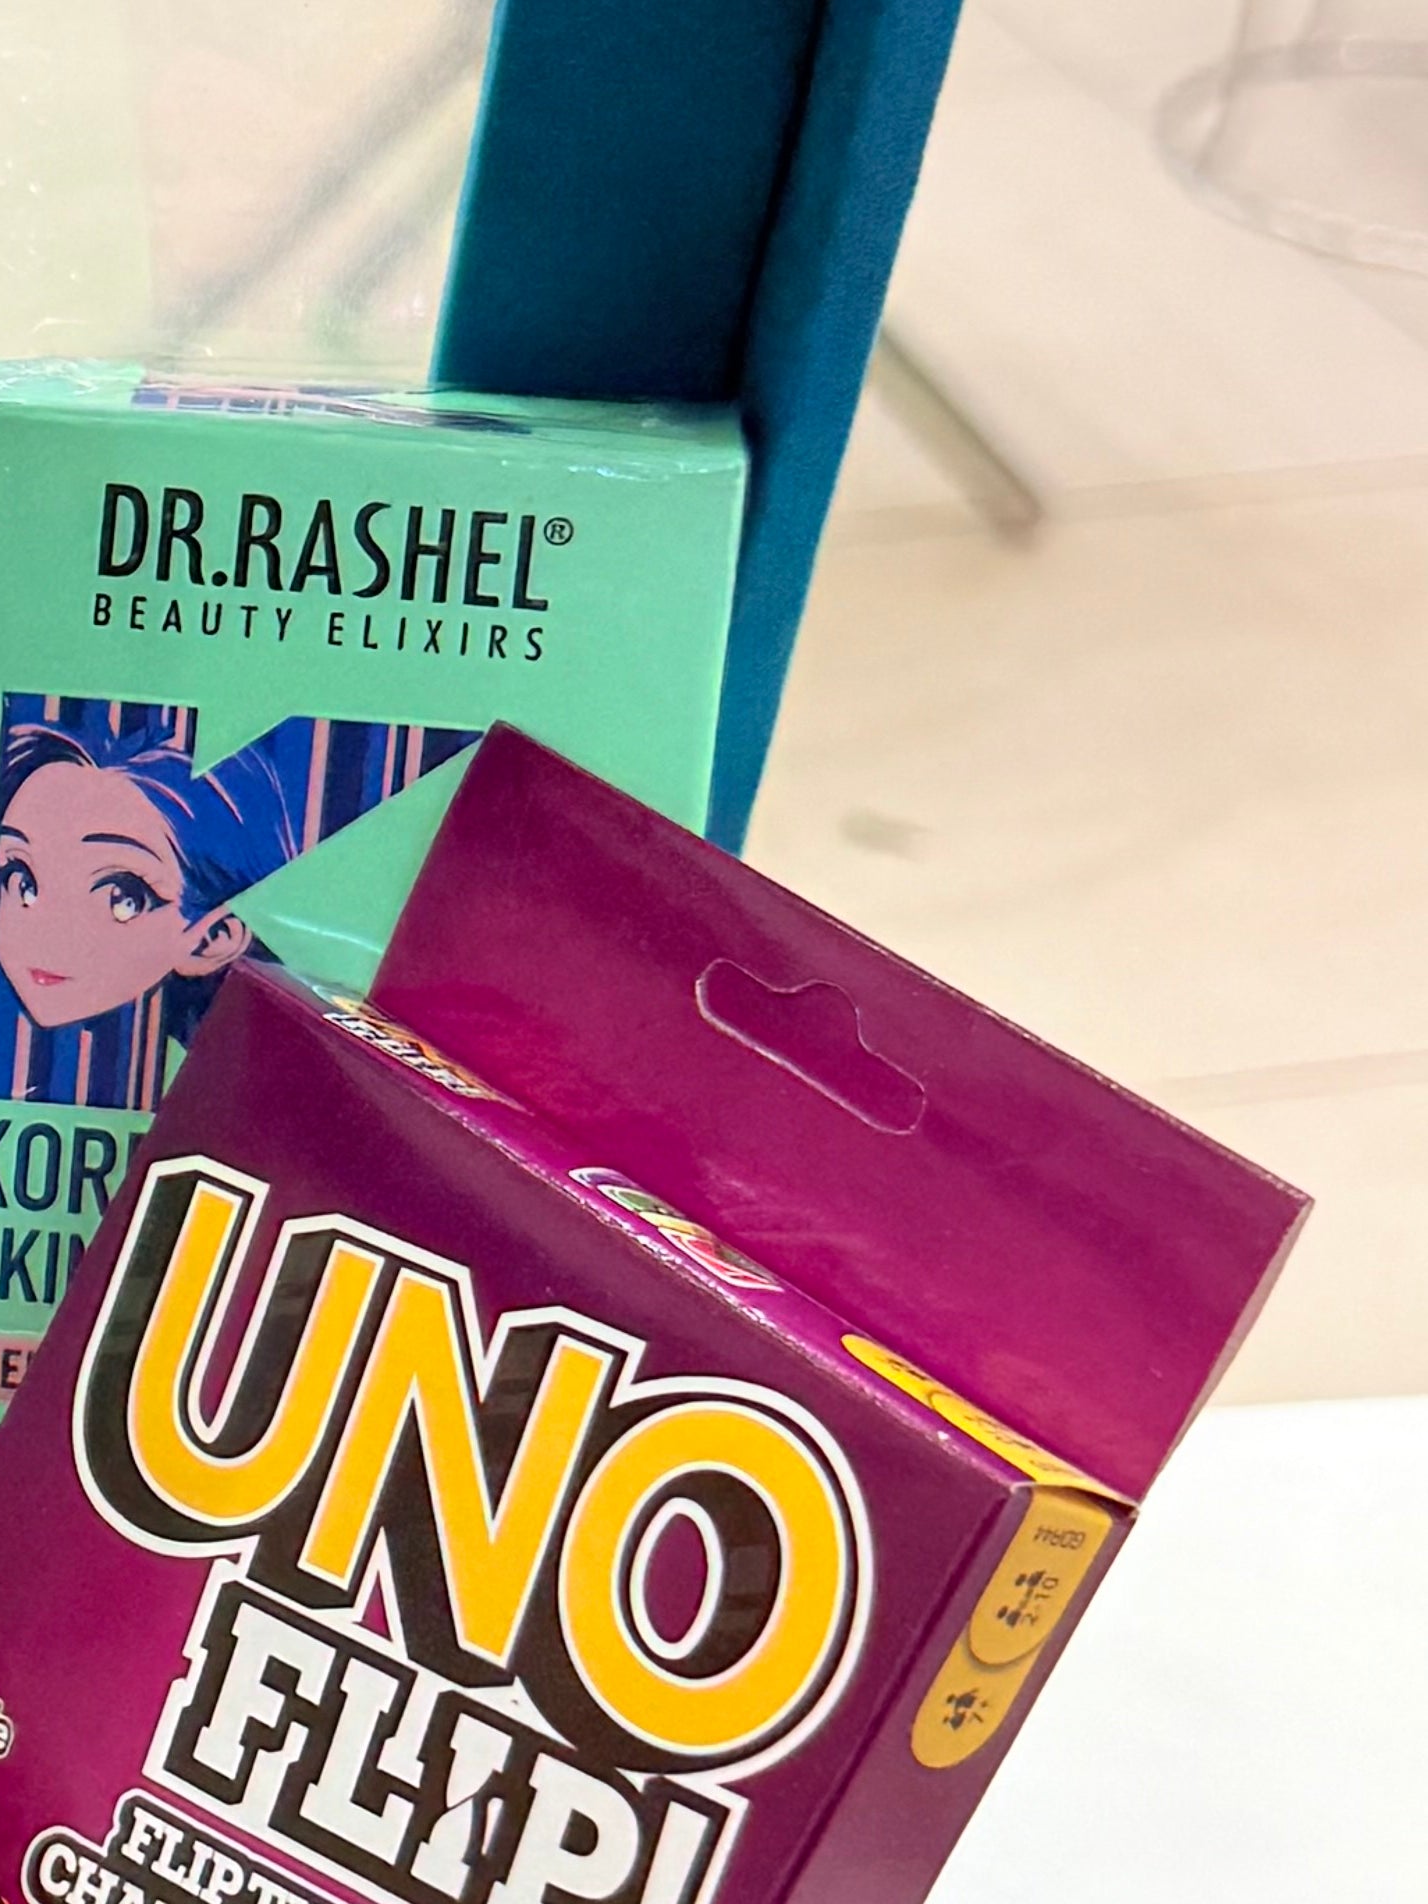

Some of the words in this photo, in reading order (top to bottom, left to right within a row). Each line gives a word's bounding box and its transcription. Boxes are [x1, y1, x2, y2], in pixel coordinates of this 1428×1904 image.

[93, 592, 293, 641] BEAUTY
[327, 613, 546, 661] ELIXIRS
[82, 1168, 865, 1769] UNO
